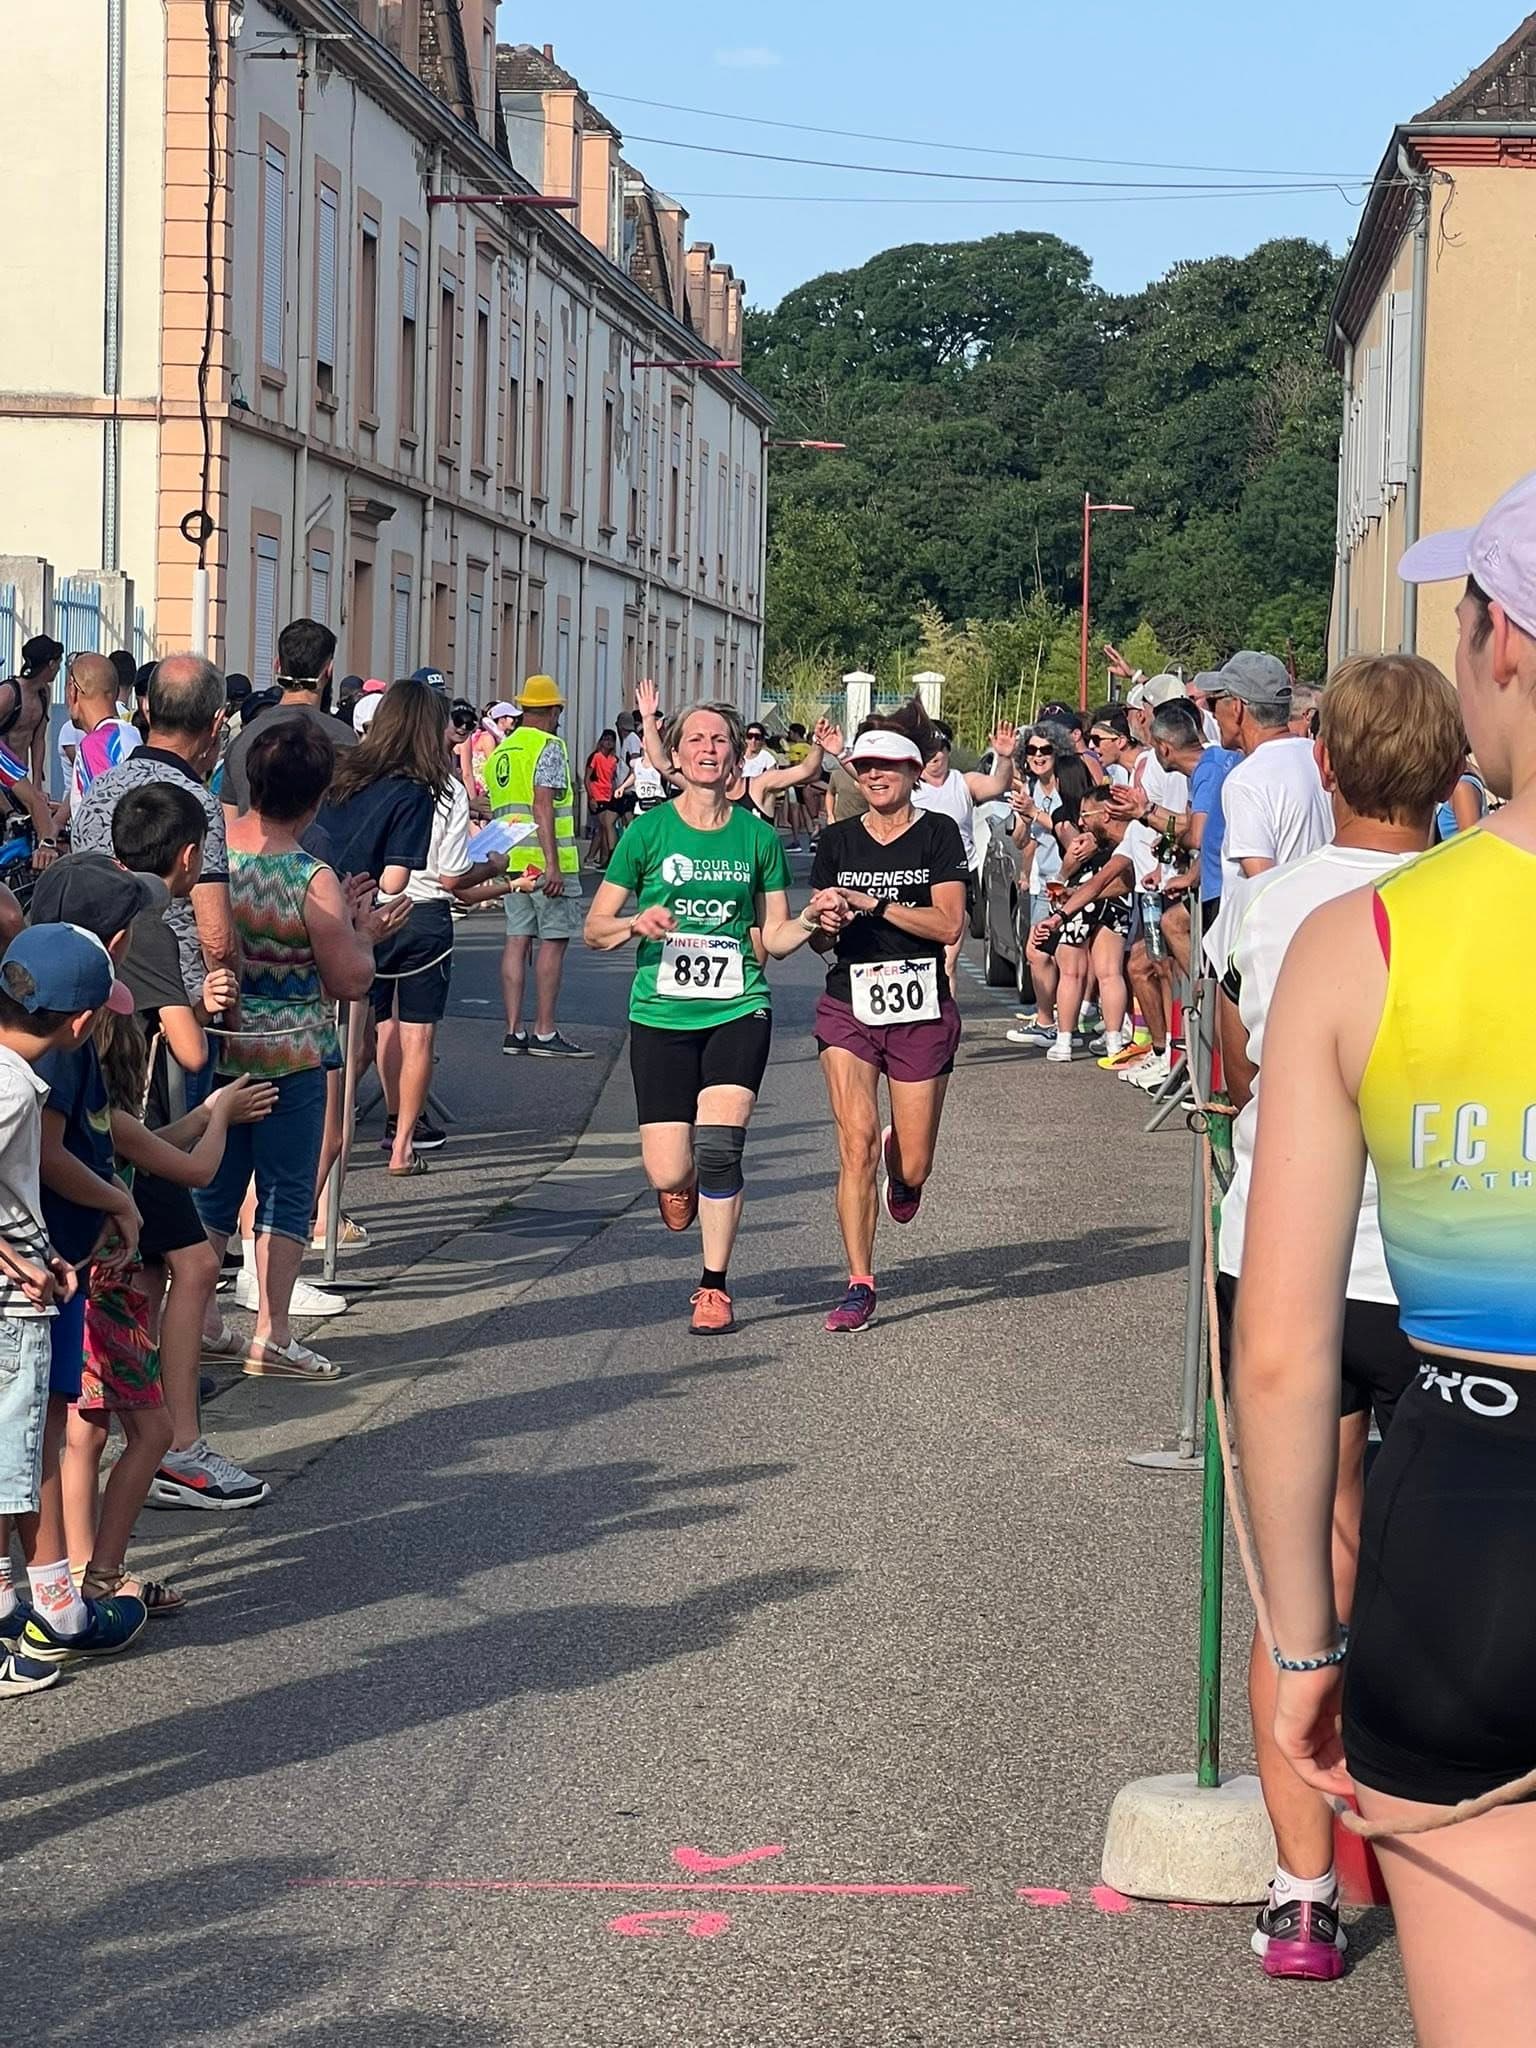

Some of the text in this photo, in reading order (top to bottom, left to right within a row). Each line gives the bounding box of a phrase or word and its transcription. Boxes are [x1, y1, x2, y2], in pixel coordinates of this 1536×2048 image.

[693, 860, 750, 873] TOUR DU
[693, 871, 751, 884] CANTON
[836, 868, 930, 887] VENDENESSE
[866, 887, 899, 901] SUR
[674, 954, 729, 988] 837
[869, 980, 924, 1015] 830
